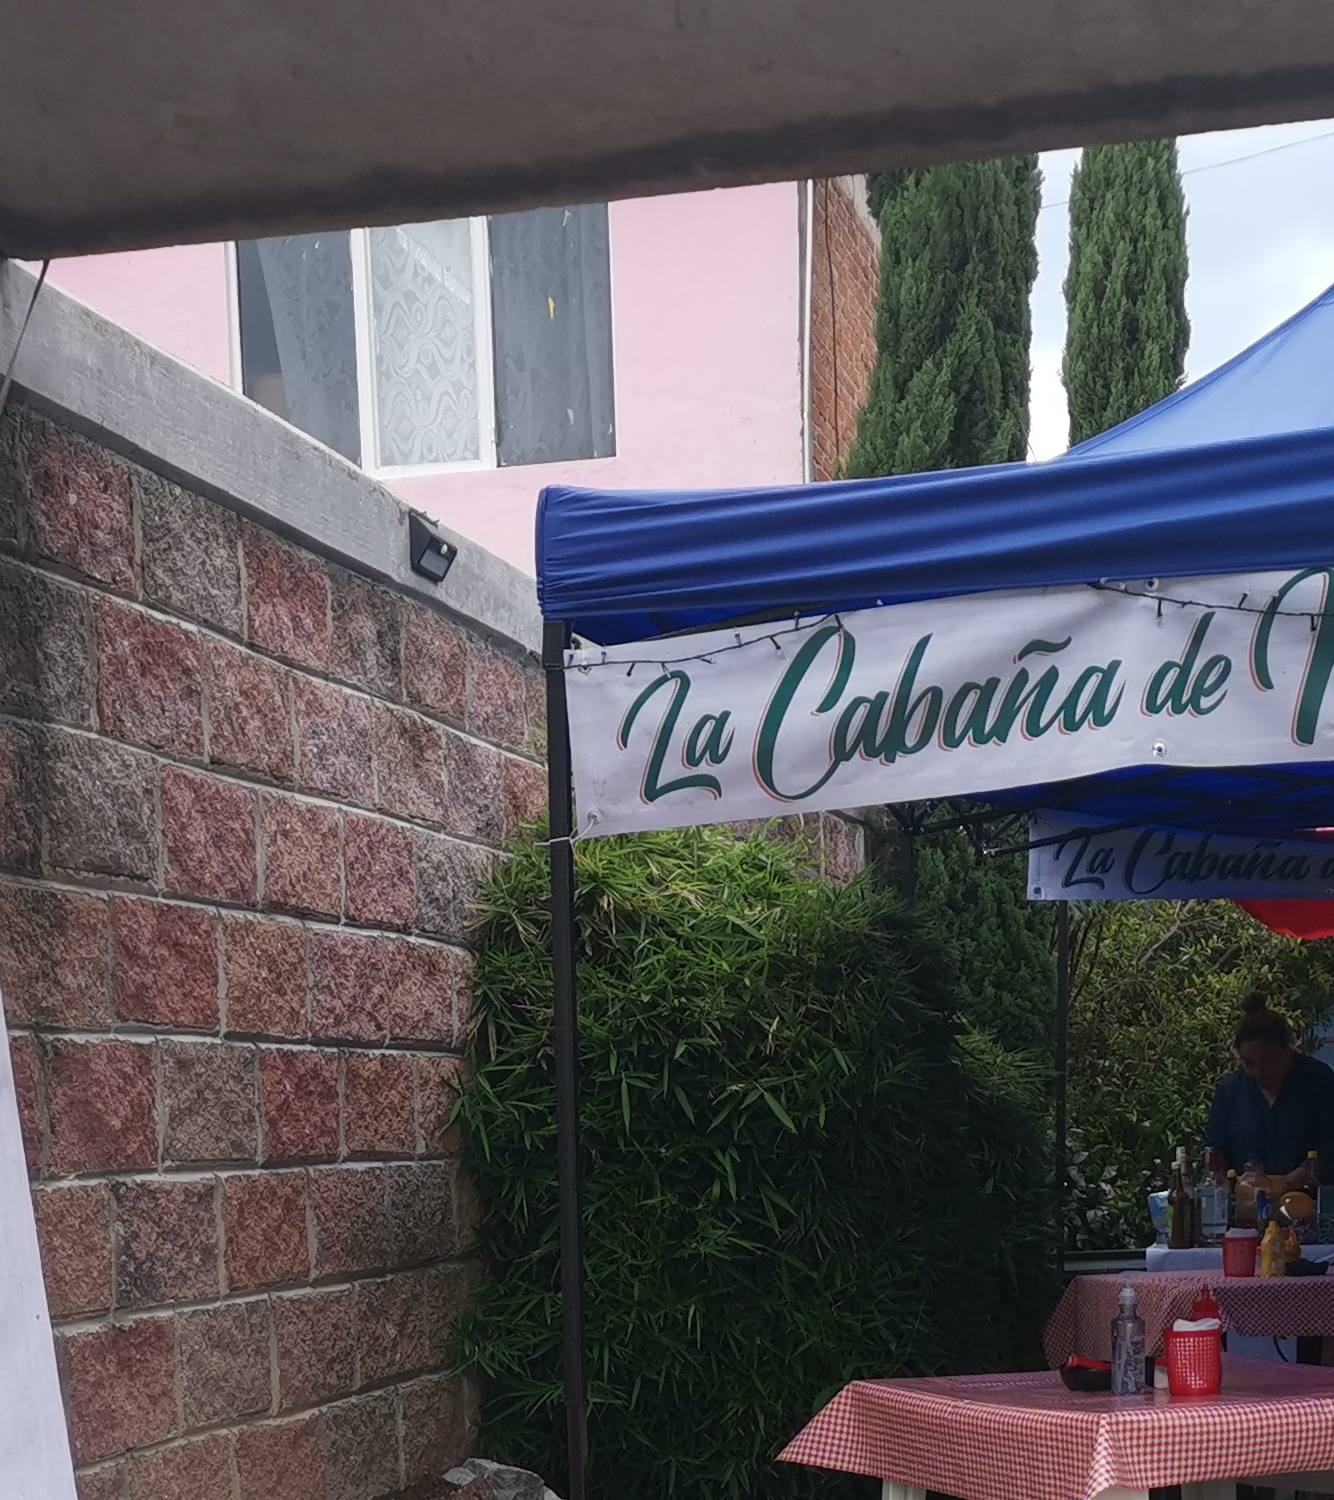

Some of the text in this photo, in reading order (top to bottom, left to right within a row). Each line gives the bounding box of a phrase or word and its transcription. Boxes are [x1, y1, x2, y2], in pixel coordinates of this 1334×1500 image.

[617, 669, 735, 804] La
[753, 625, 1125, 802] Cabaña
[1140, 612, 1233, 719] de
[1053, 832, 1114, 891] La
[1123, 824, 1310, 894] Cabaña
